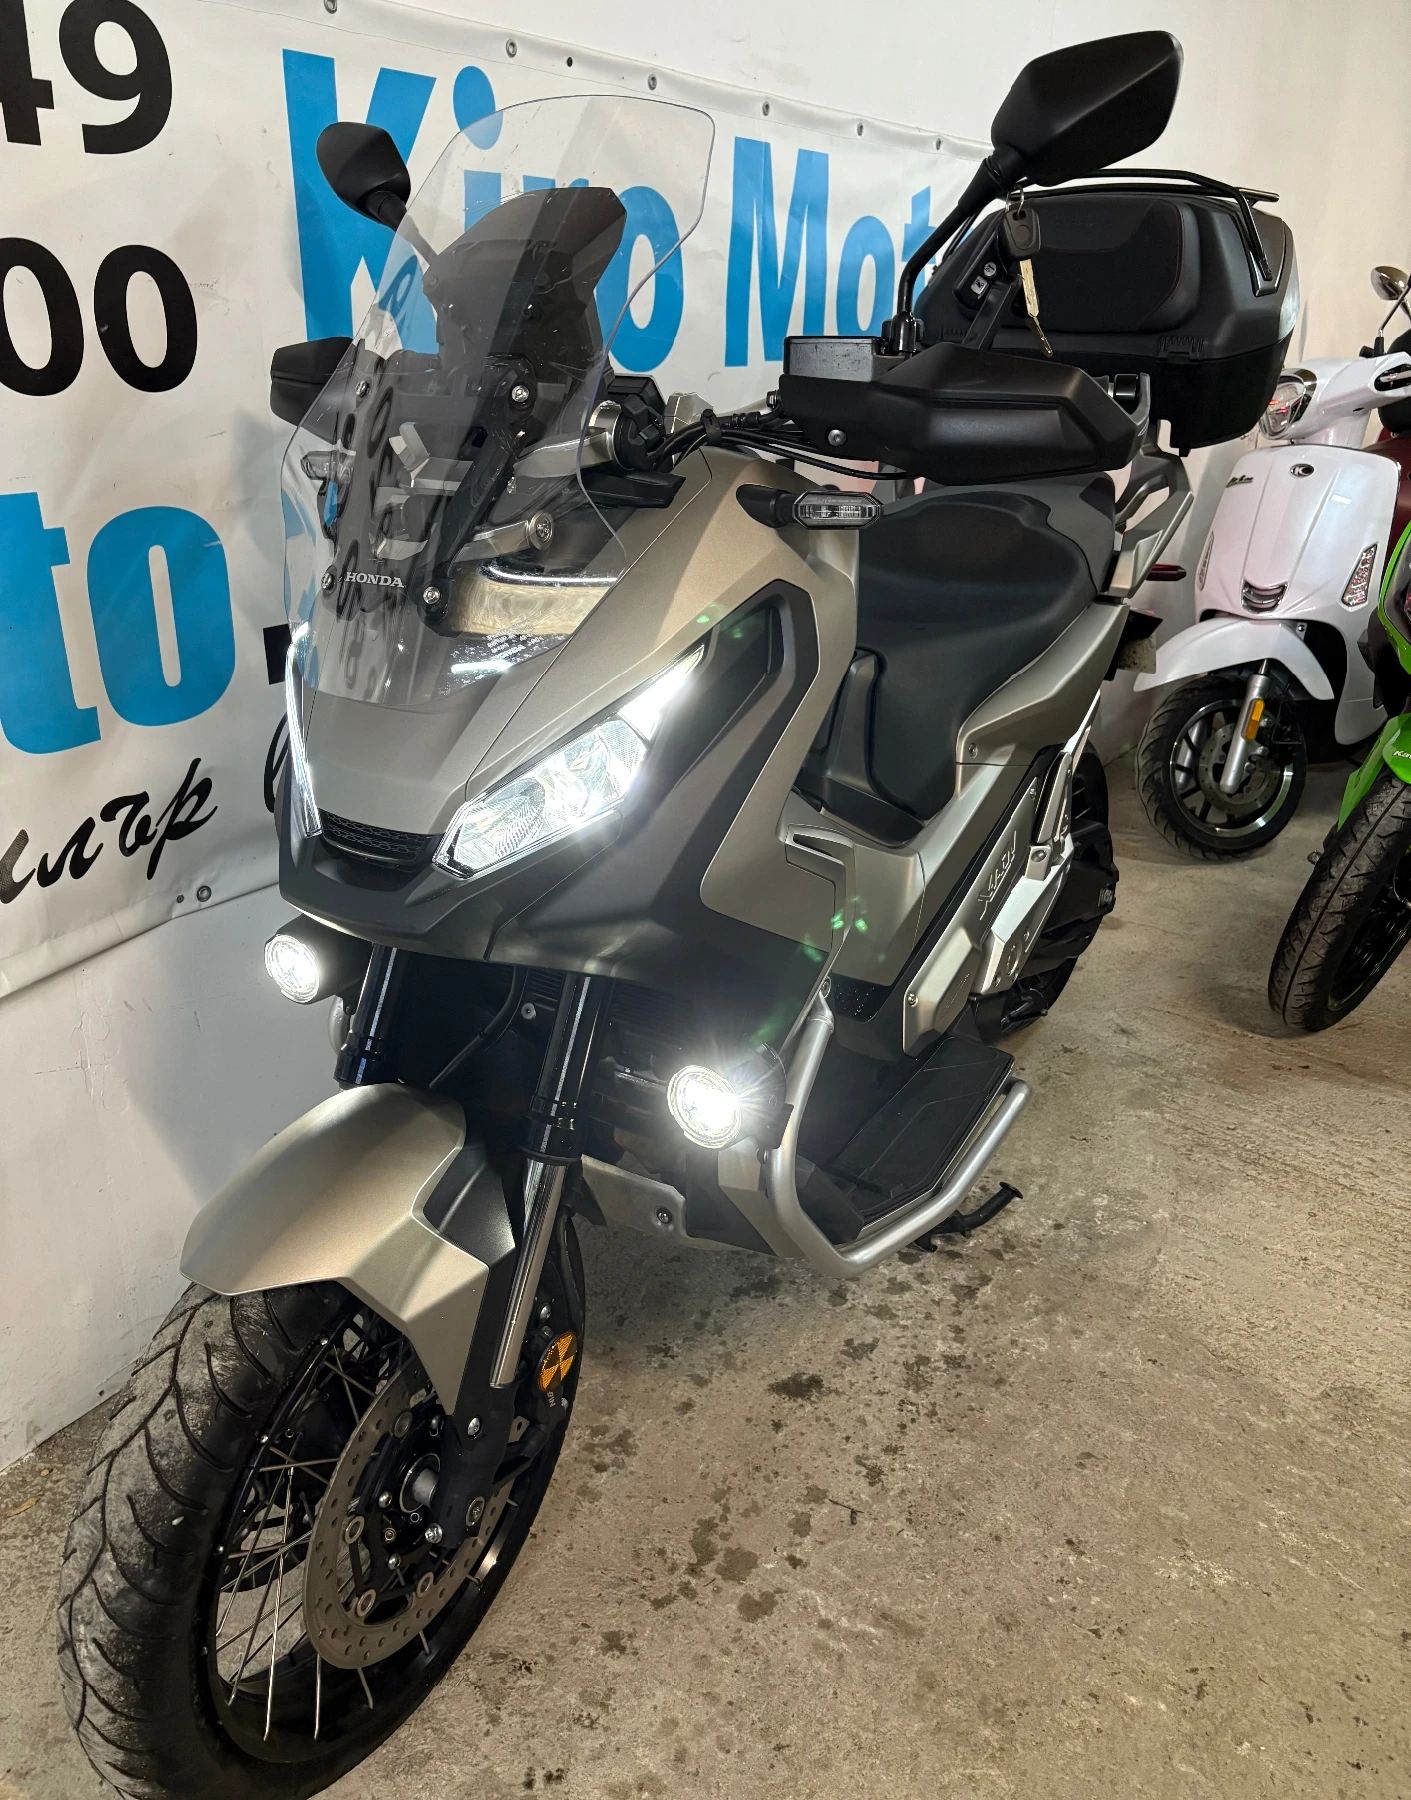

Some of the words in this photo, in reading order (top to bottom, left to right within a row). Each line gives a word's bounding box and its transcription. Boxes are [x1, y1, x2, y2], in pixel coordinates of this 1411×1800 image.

[282, 48, 685, 373] Kio
[724, 136, 938, 368] Mot
[0, 237, 198, 397] 00
[0, 491, 236, 756] to
[344, 571, 405, 589] HONDA
